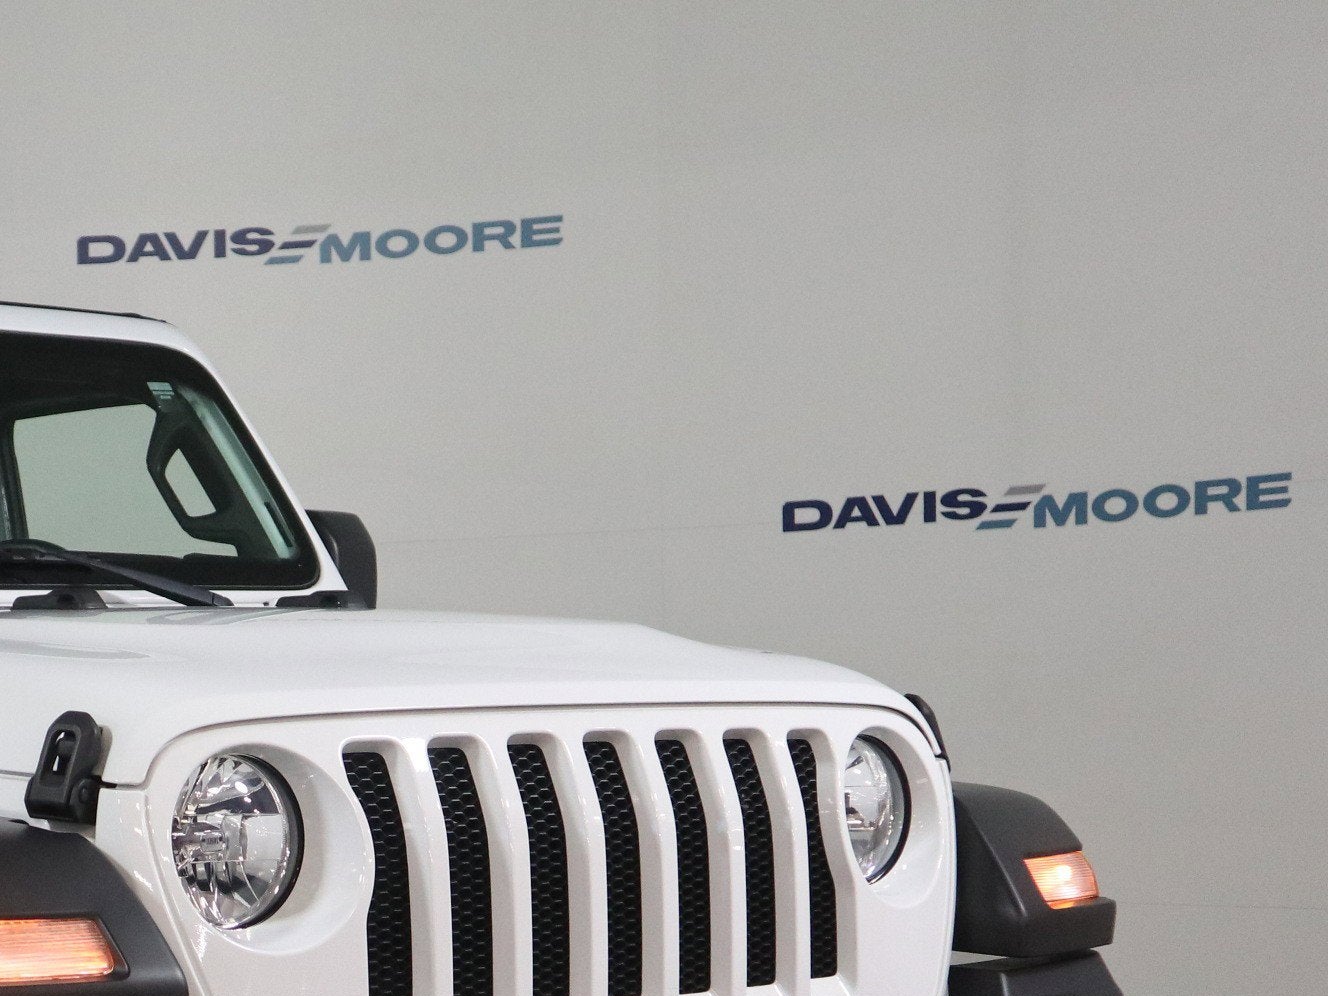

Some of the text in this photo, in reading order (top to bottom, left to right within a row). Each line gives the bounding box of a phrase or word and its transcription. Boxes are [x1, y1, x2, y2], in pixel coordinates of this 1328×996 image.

[76, 214, 563, 265] DAVIS MOORE
[782, 472, 1292, 532] DAVIS MOORE
